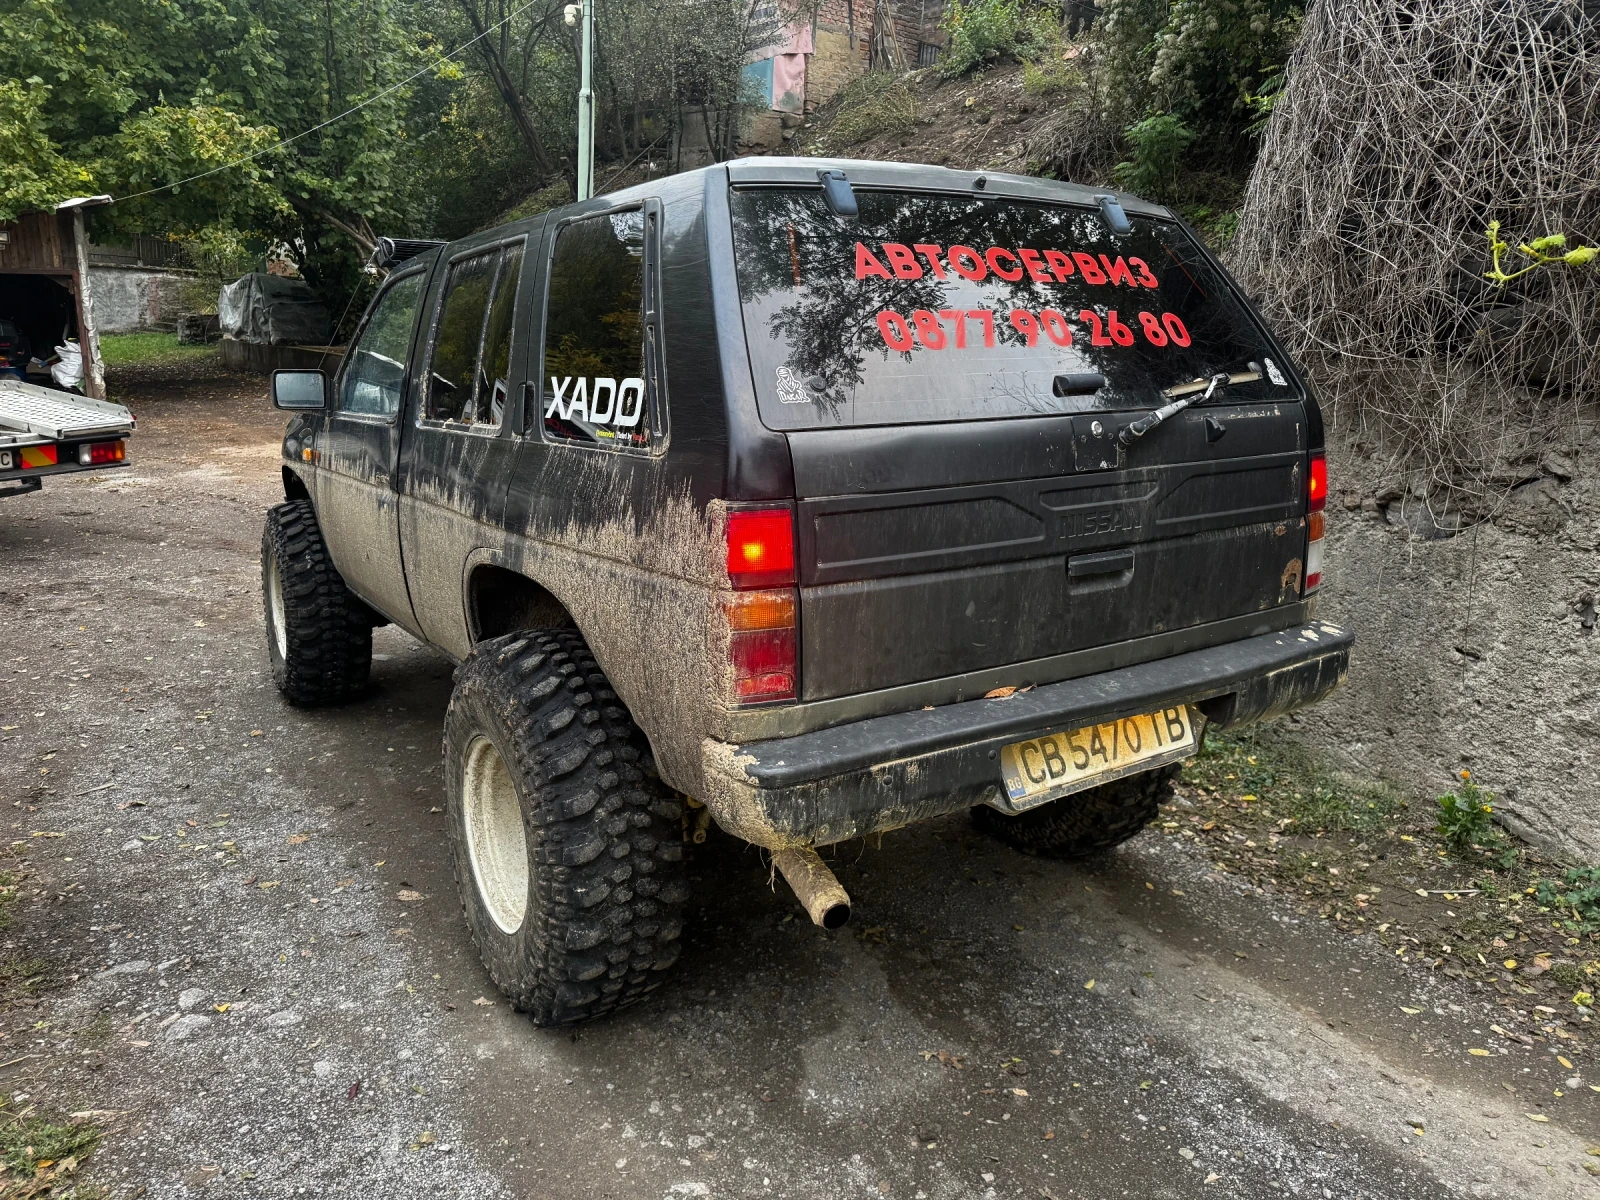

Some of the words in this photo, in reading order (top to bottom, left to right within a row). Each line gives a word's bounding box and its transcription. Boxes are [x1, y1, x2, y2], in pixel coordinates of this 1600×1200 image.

[856, 242, 1159, 289] АВТОСЕРВИЗ
[876, 309, 995, 352] 0877
[1010, 309, 1073, 348] 90
[1080, 309, 1135, 347] 26
[1139, 311, 1191, 348] 80
[545, 376, 644, 426] XADO
[1059, 509, 1142, 539] NISSAN
[1021, 736, 1067, 784] CB
[1068, 718, 1142, 770] 5470
[1144, 708, 1186, 747] TB
[1007, 776, 1022, 790] BG
